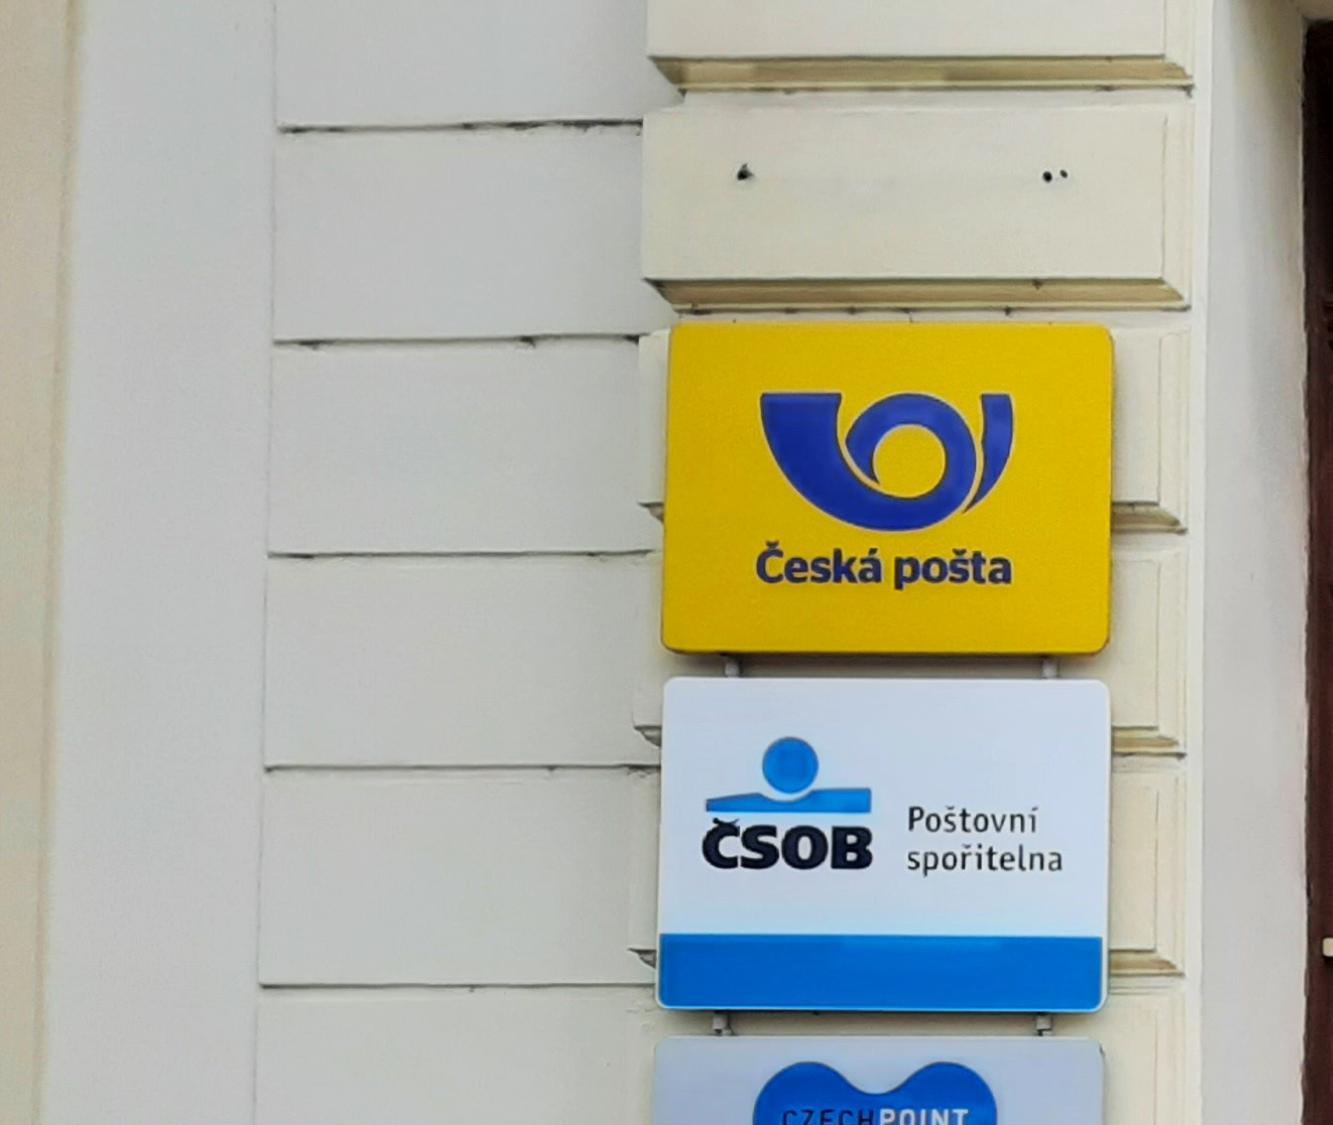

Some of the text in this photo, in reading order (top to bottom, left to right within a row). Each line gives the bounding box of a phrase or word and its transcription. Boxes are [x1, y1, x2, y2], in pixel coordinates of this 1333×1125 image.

[756, 541, 1012, 590] Česká pošta
[907, 805, 1040, 834] Poštovní
[702, 817, 874, 870] ČSOB
[907, 842, 1064, 878] spořitelna
